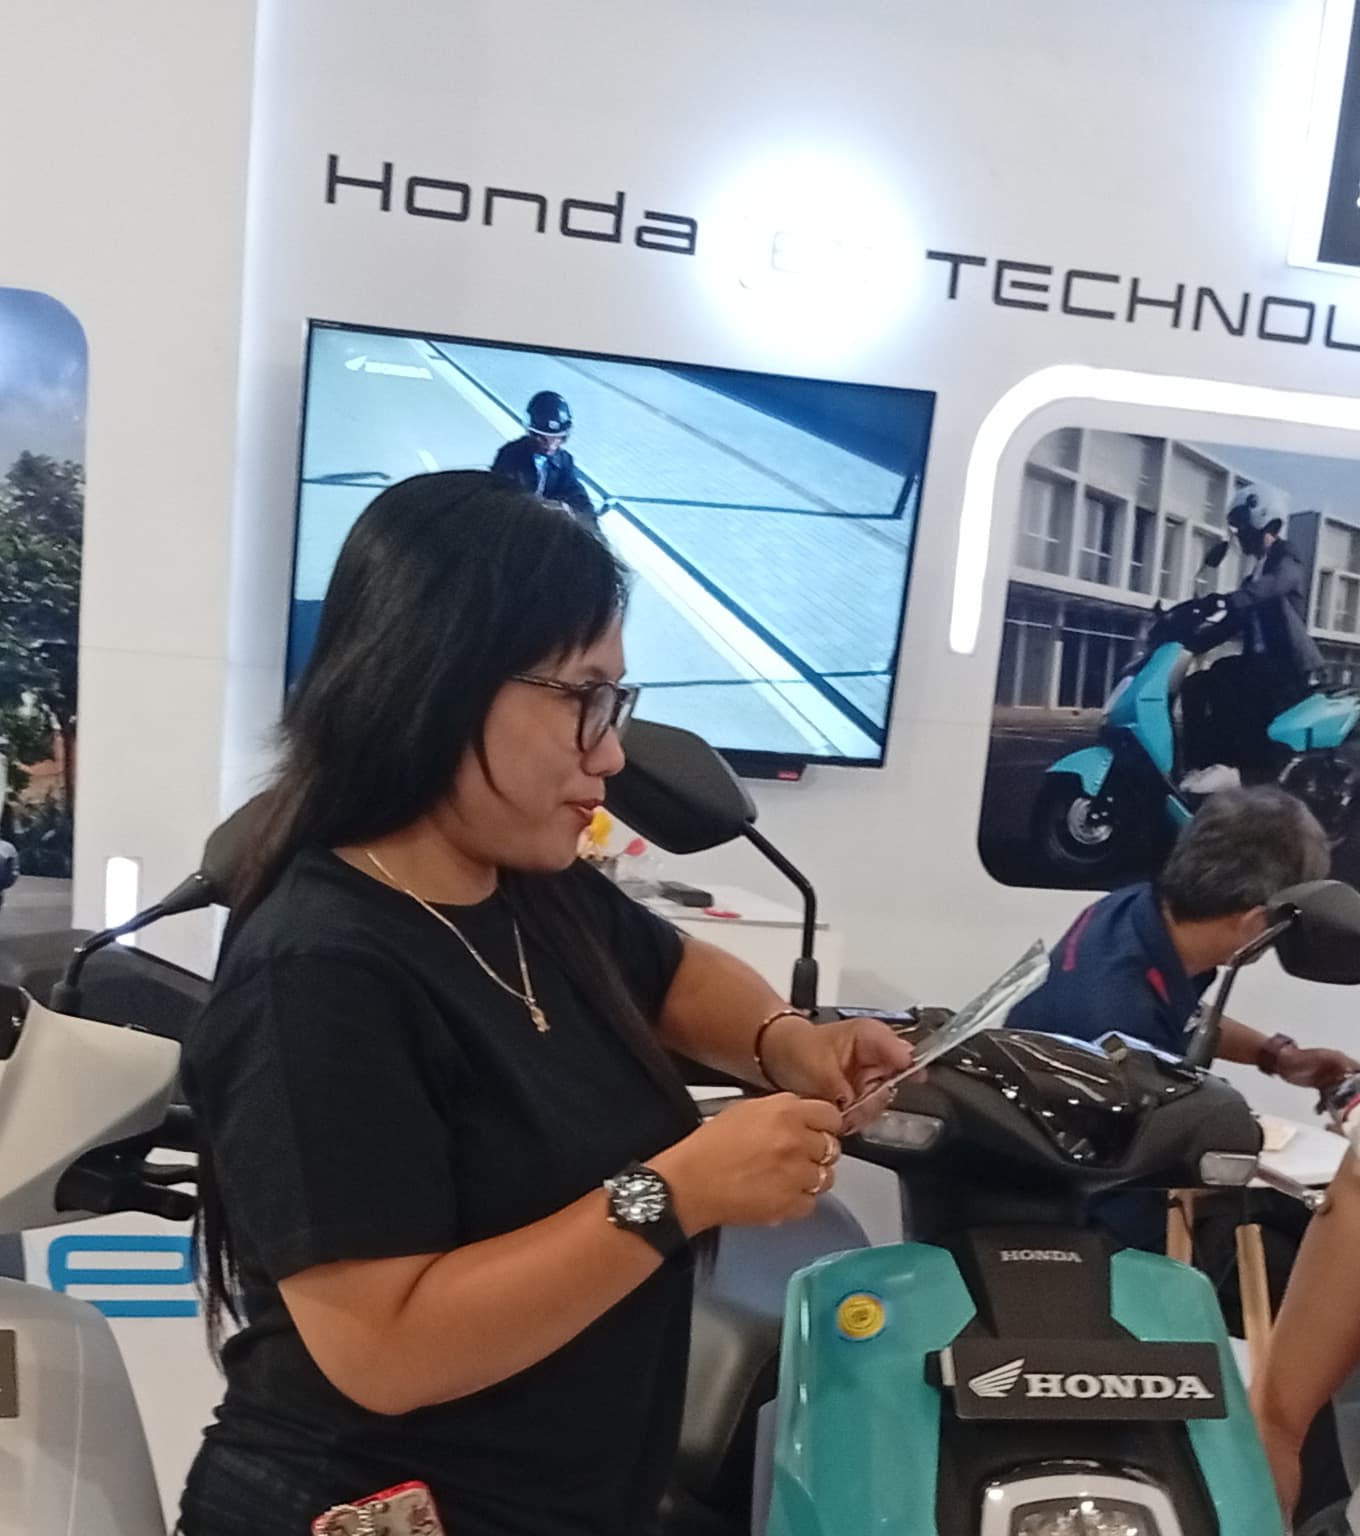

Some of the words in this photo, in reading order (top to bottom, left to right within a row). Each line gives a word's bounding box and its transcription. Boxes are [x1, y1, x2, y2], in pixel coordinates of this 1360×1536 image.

[324, 152, 698, 255] Honda
[1000, 1249, 1083, 1264] HONDA
[1024, 1373, 1215, 1400] HONDA
